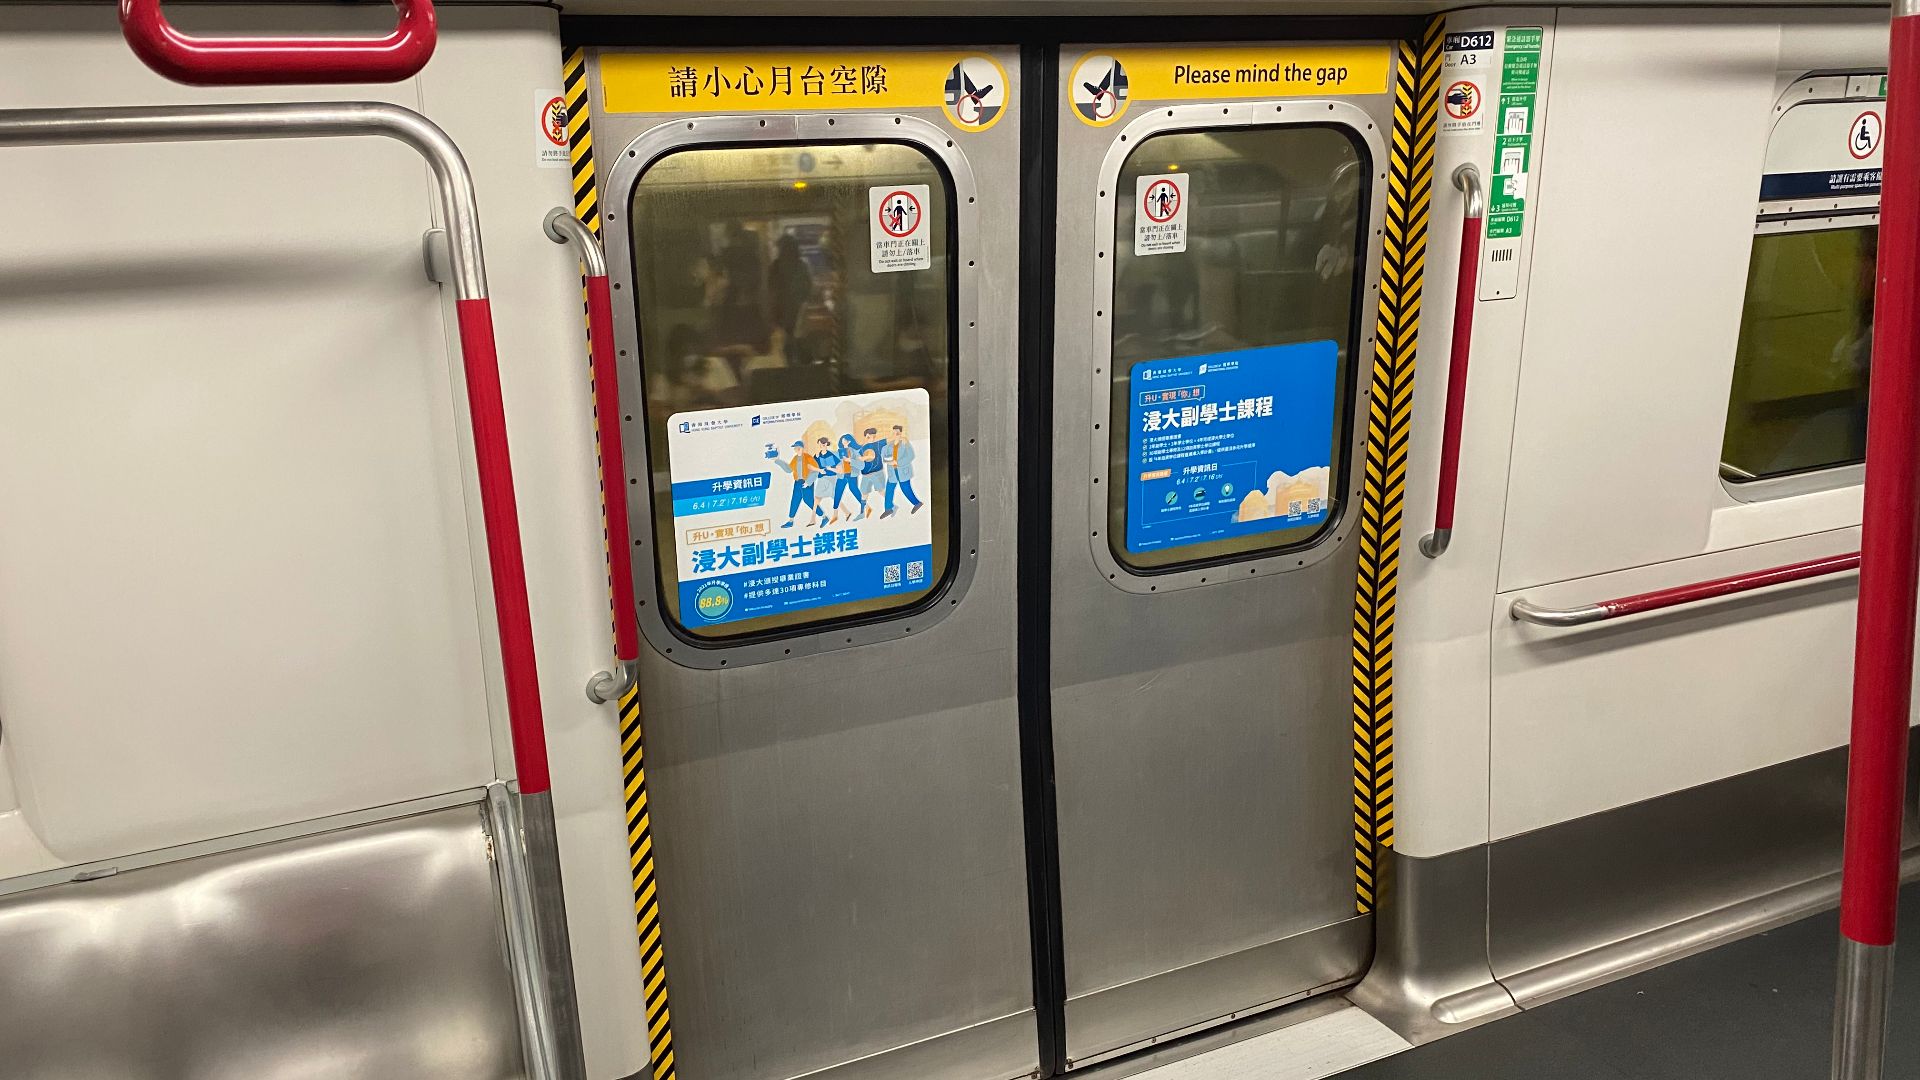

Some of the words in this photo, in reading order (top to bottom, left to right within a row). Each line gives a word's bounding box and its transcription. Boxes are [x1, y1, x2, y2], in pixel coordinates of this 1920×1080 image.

[1461, 35, 1492, 48] D612
[1460, 54, 1477, 66] A3
[668, 64, 889, 98] 請小心月台空隙
[1174, 65, 1231, 85] Please
[1235, 63, 1280, 83] mind
[1284, 63, 1312, 82] the
[1316, 65, 1348, 85] gap
[1142, 396, 1274, 432] 浸大副學士課程
[712, 477, 763, 493] 升學資訊日
[692, 502, 705, 510] 6.4
[692, 528, 859, 574] 浸大副學士課程
[699, 595, 729, 609] 88.8%
